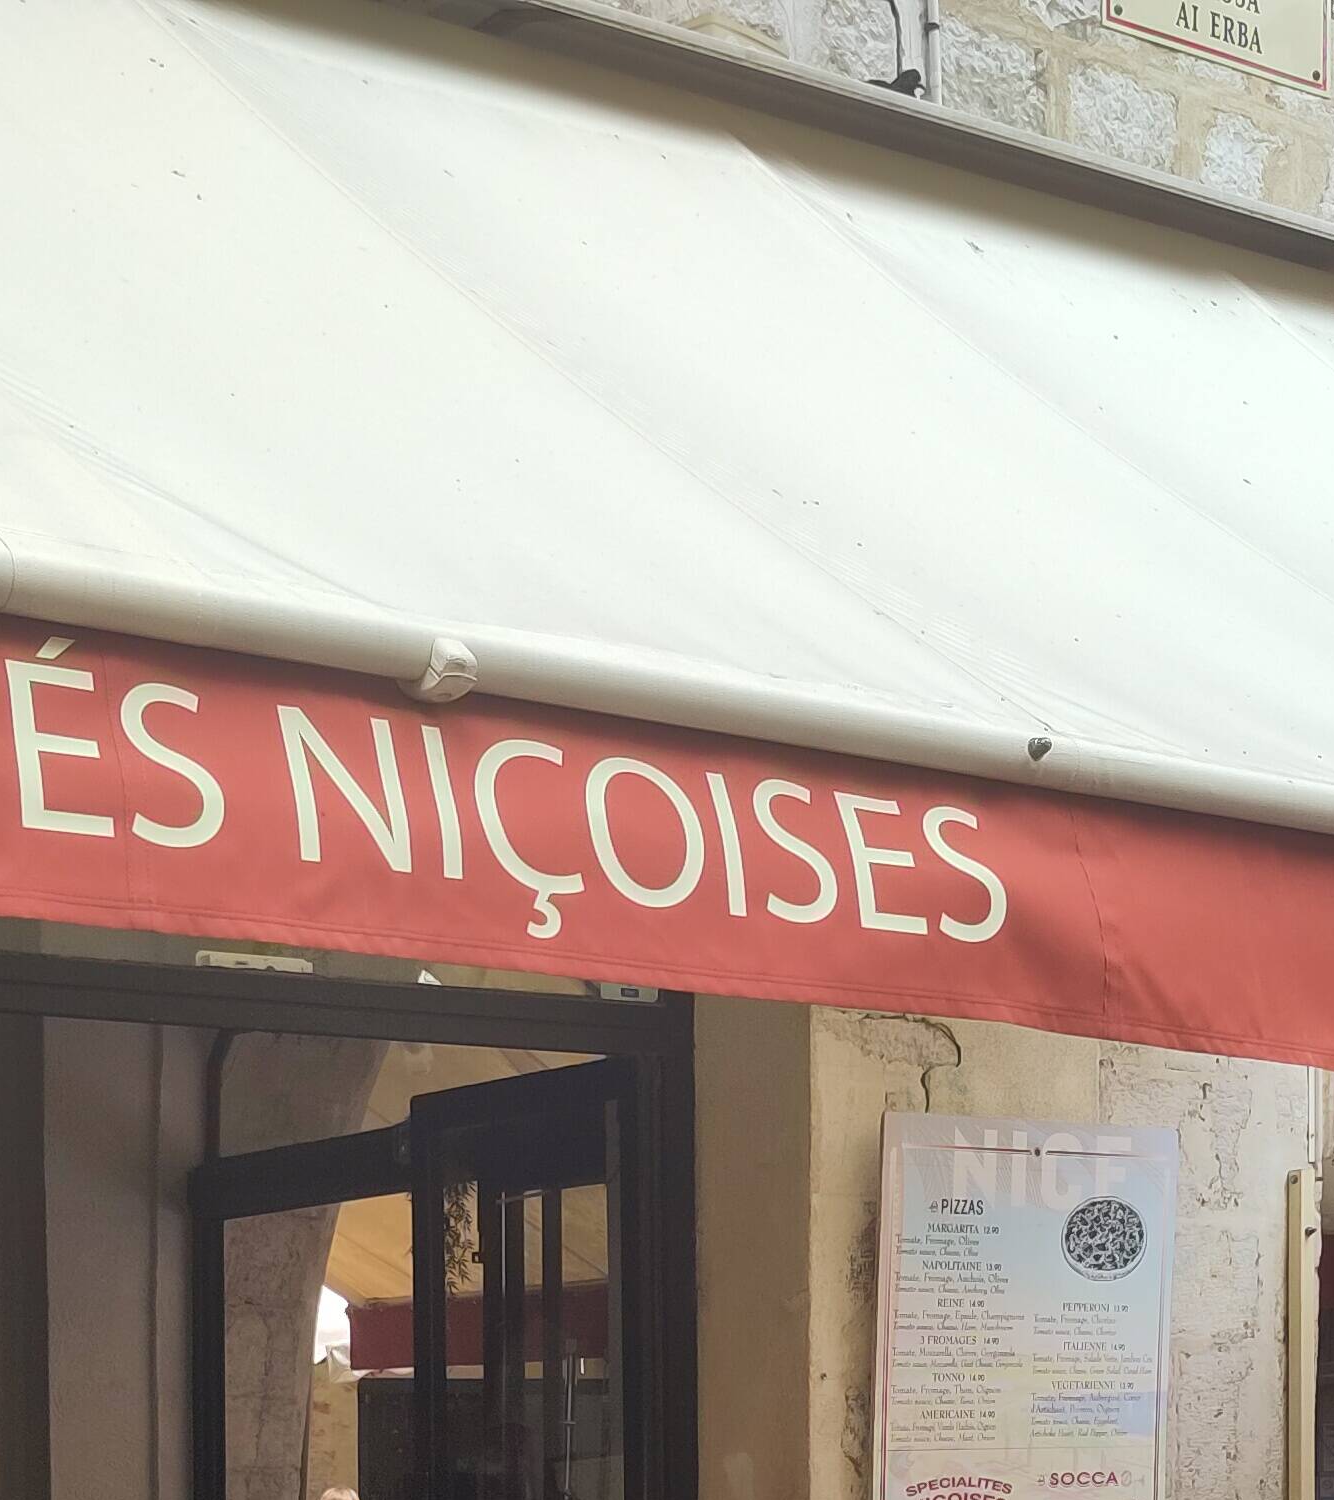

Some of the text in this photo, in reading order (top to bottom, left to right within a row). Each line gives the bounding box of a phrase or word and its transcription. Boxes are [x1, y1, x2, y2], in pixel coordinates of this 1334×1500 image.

[1209, 11, 1263, 54] ERBA
[276, 703, 1008, 941] NIÇOISES
[941, 1198, 984, 1216] PIZZAS
[927, 1223, 1000, 1235] MARGARITA 12.90
[922, 1261, 982, 1271] NAPOLITAINE
[937, 1298, 965, 1307] REINE
[927, 1336, 977, 1345] FROMAGES
[1063, 1342, 1106, 1351] ITALIENNE
[932, 1373, 965, 1382] TONNO
[920, 1410, 975, 1419] AMERICAINE
[1050, 1471, 1118, 1487] SOCCA
[905, 1476, 1013, 1497] SPECIALITES
